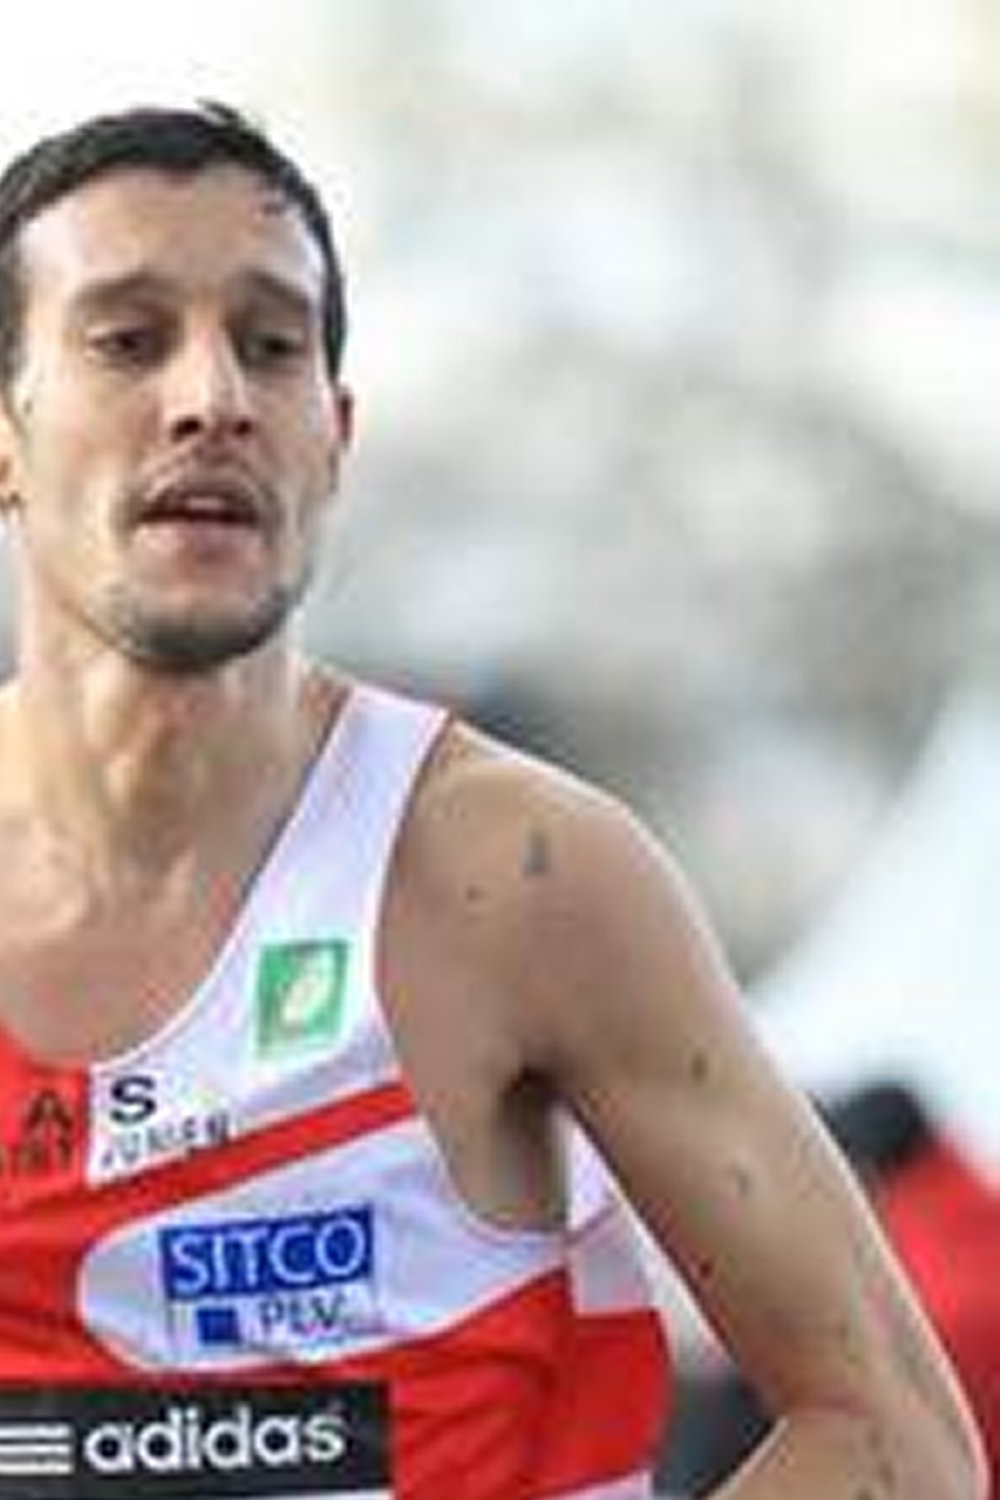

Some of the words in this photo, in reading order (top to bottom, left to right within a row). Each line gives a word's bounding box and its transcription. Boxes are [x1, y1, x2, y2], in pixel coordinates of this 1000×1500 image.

[24, 1086, 74, 1129] A
[109, 1073, 157, 1125] S
[169, 1216, 366, 1293] SITCO
[83, 1404, 347, 1474] adidas
